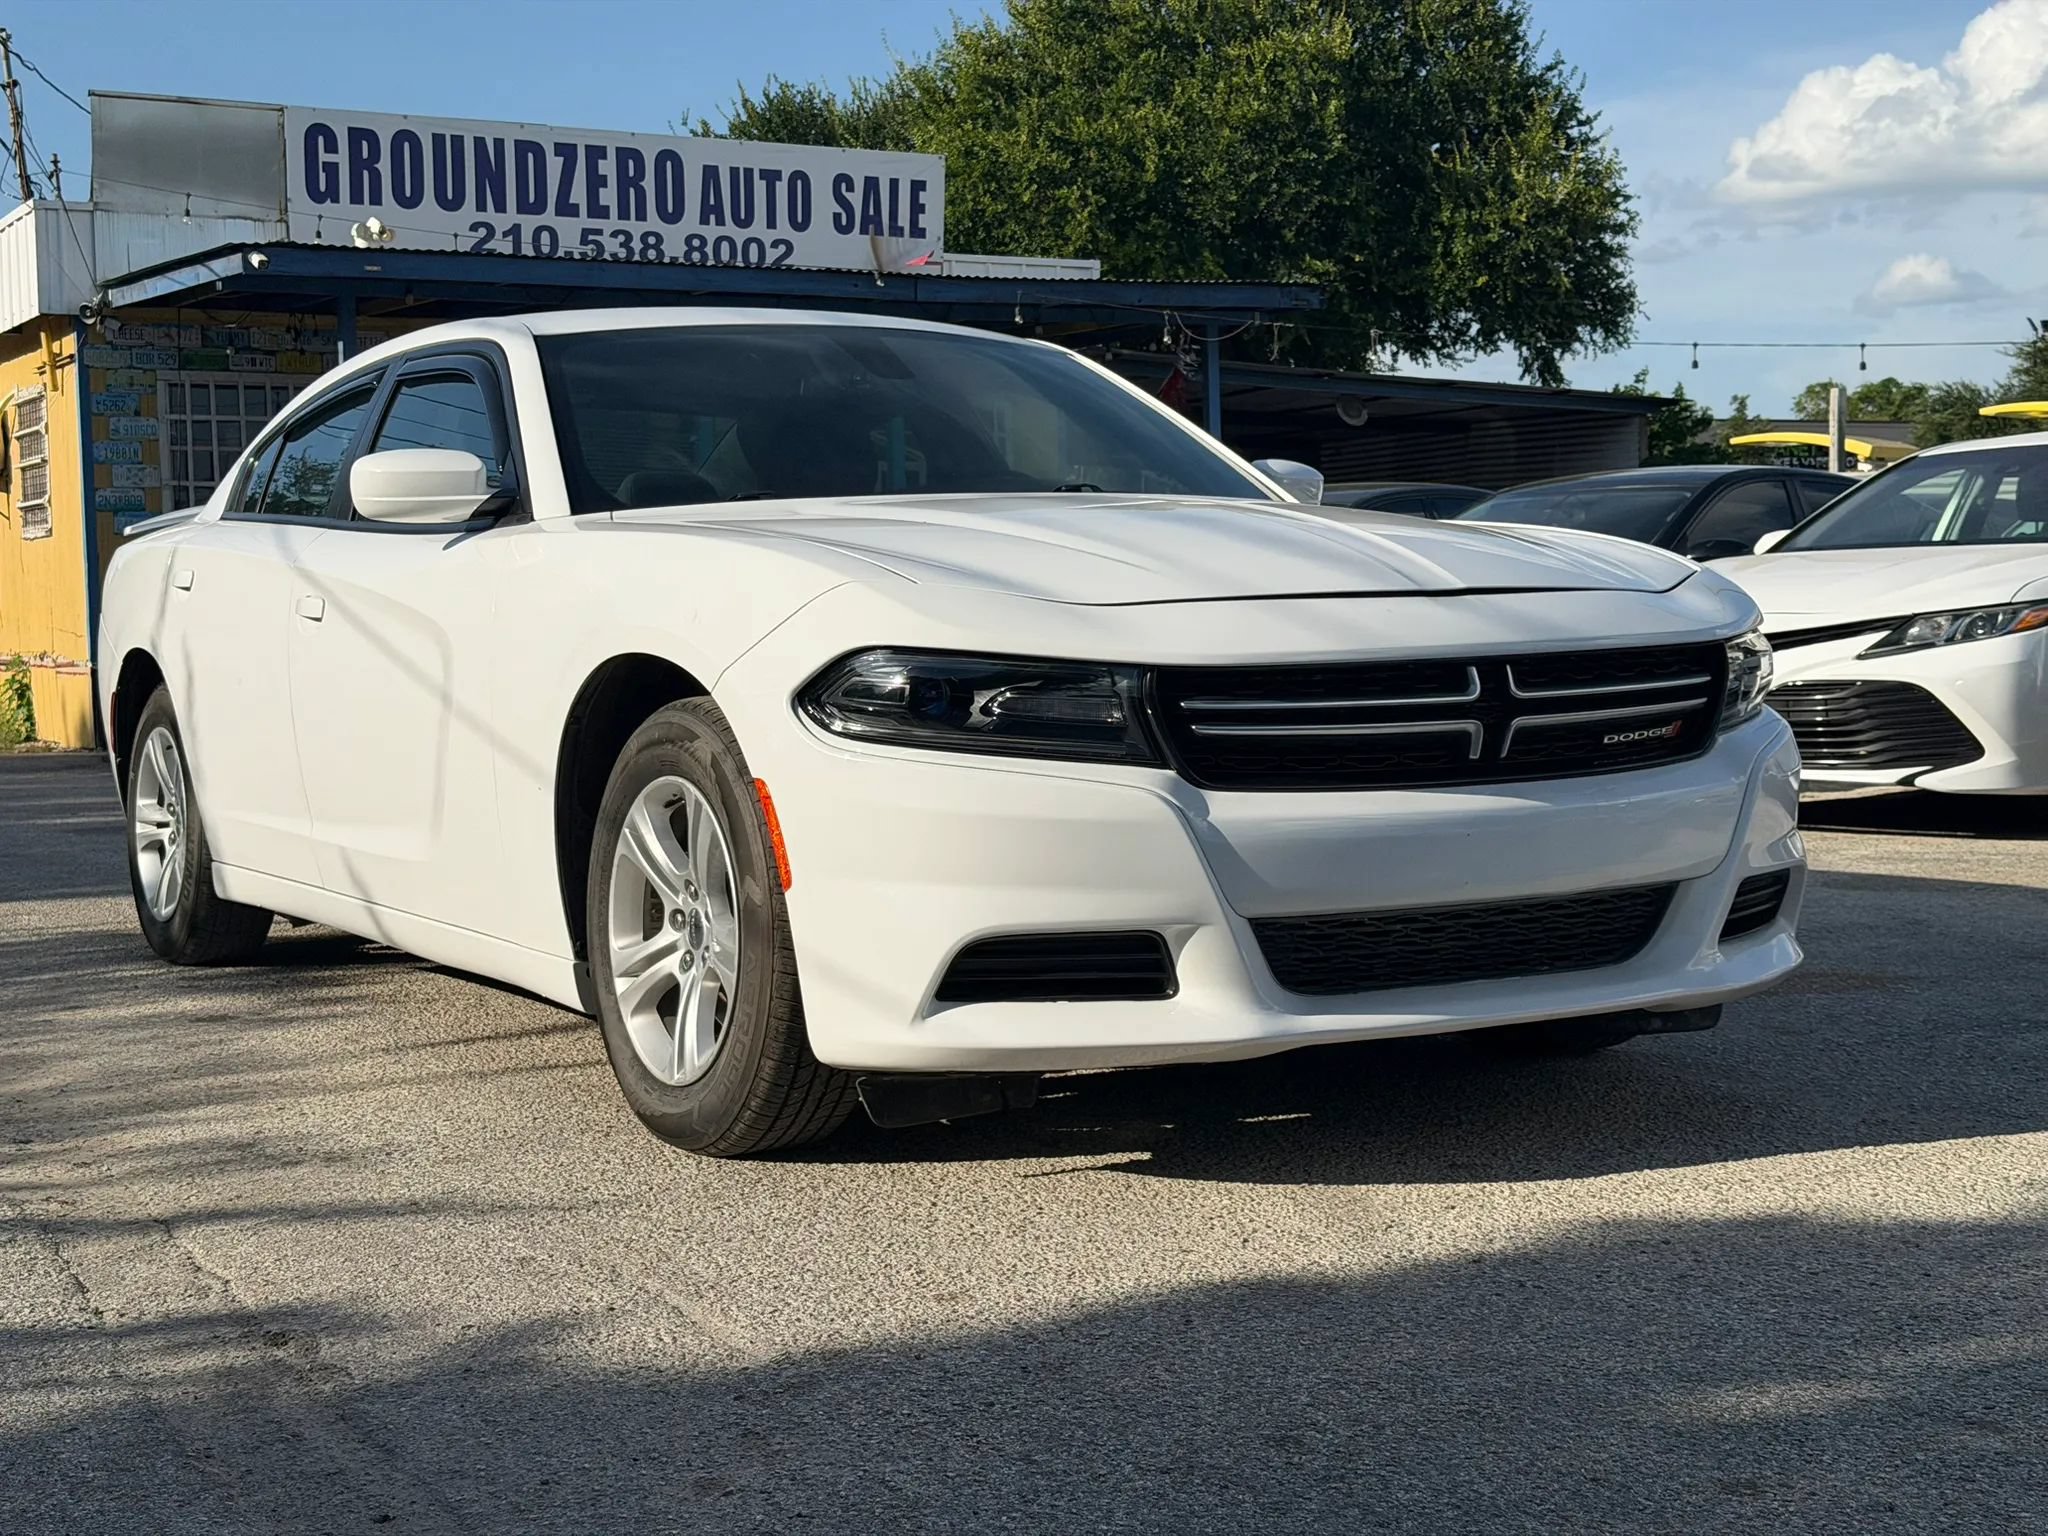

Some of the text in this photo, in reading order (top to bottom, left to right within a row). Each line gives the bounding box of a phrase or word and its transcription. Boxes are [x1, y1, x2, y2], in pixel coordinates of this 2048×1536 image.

[303, 122, 927, 239] GROUNDZERO AUTO SALE
[468, 221, 796, 269] 210.538.8002
[1603, 726, 1674, 743] DODGE
